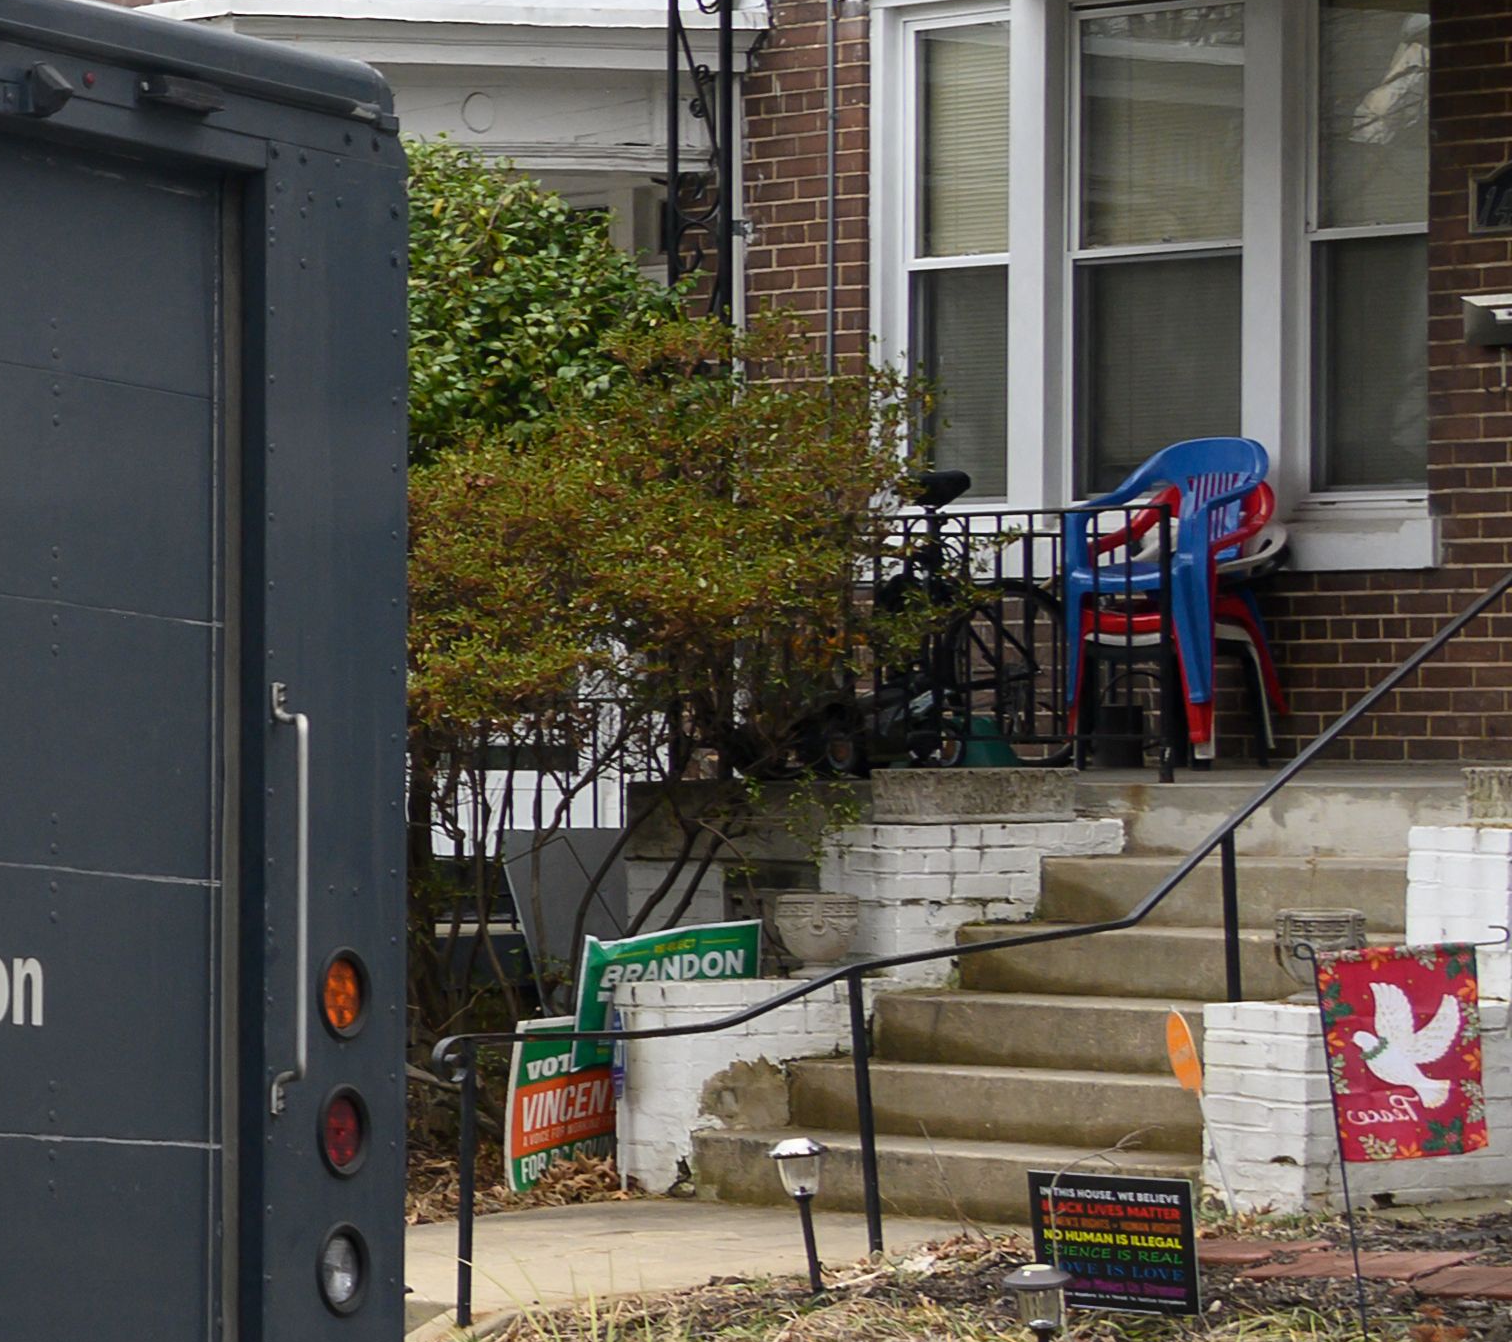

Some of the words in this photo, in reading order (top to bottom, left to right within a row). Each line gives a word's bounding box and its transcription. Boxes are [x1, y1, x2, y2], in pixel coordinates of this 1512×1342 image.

[599, 949, 745, 988] BRANDON
[526, 1053, 571, 1080] VOT
[1054, 1187, 1075, 1198] THIS
[1117, 1192, 1135, 1202] WE
[1136, 1193, 1181, 1205] BELIEVE
[1087, 1204, 1125, 1217] LIVES
[1127, 1207, 1181, 1221] MATTER
[1043, 1228, 1063, 1241] NO
[1065, 1230, 1114, 1245] HUMAN
[1116, 1234, 1129, 1246] IS
[1130, 1235, 1183, 1250] ILLEGAL
[1117, 1249, 1132, 1261] IS
[1138, 1250, 1183, 1265] REAL
[1132, 1265, 1185, 1282] LOVE
